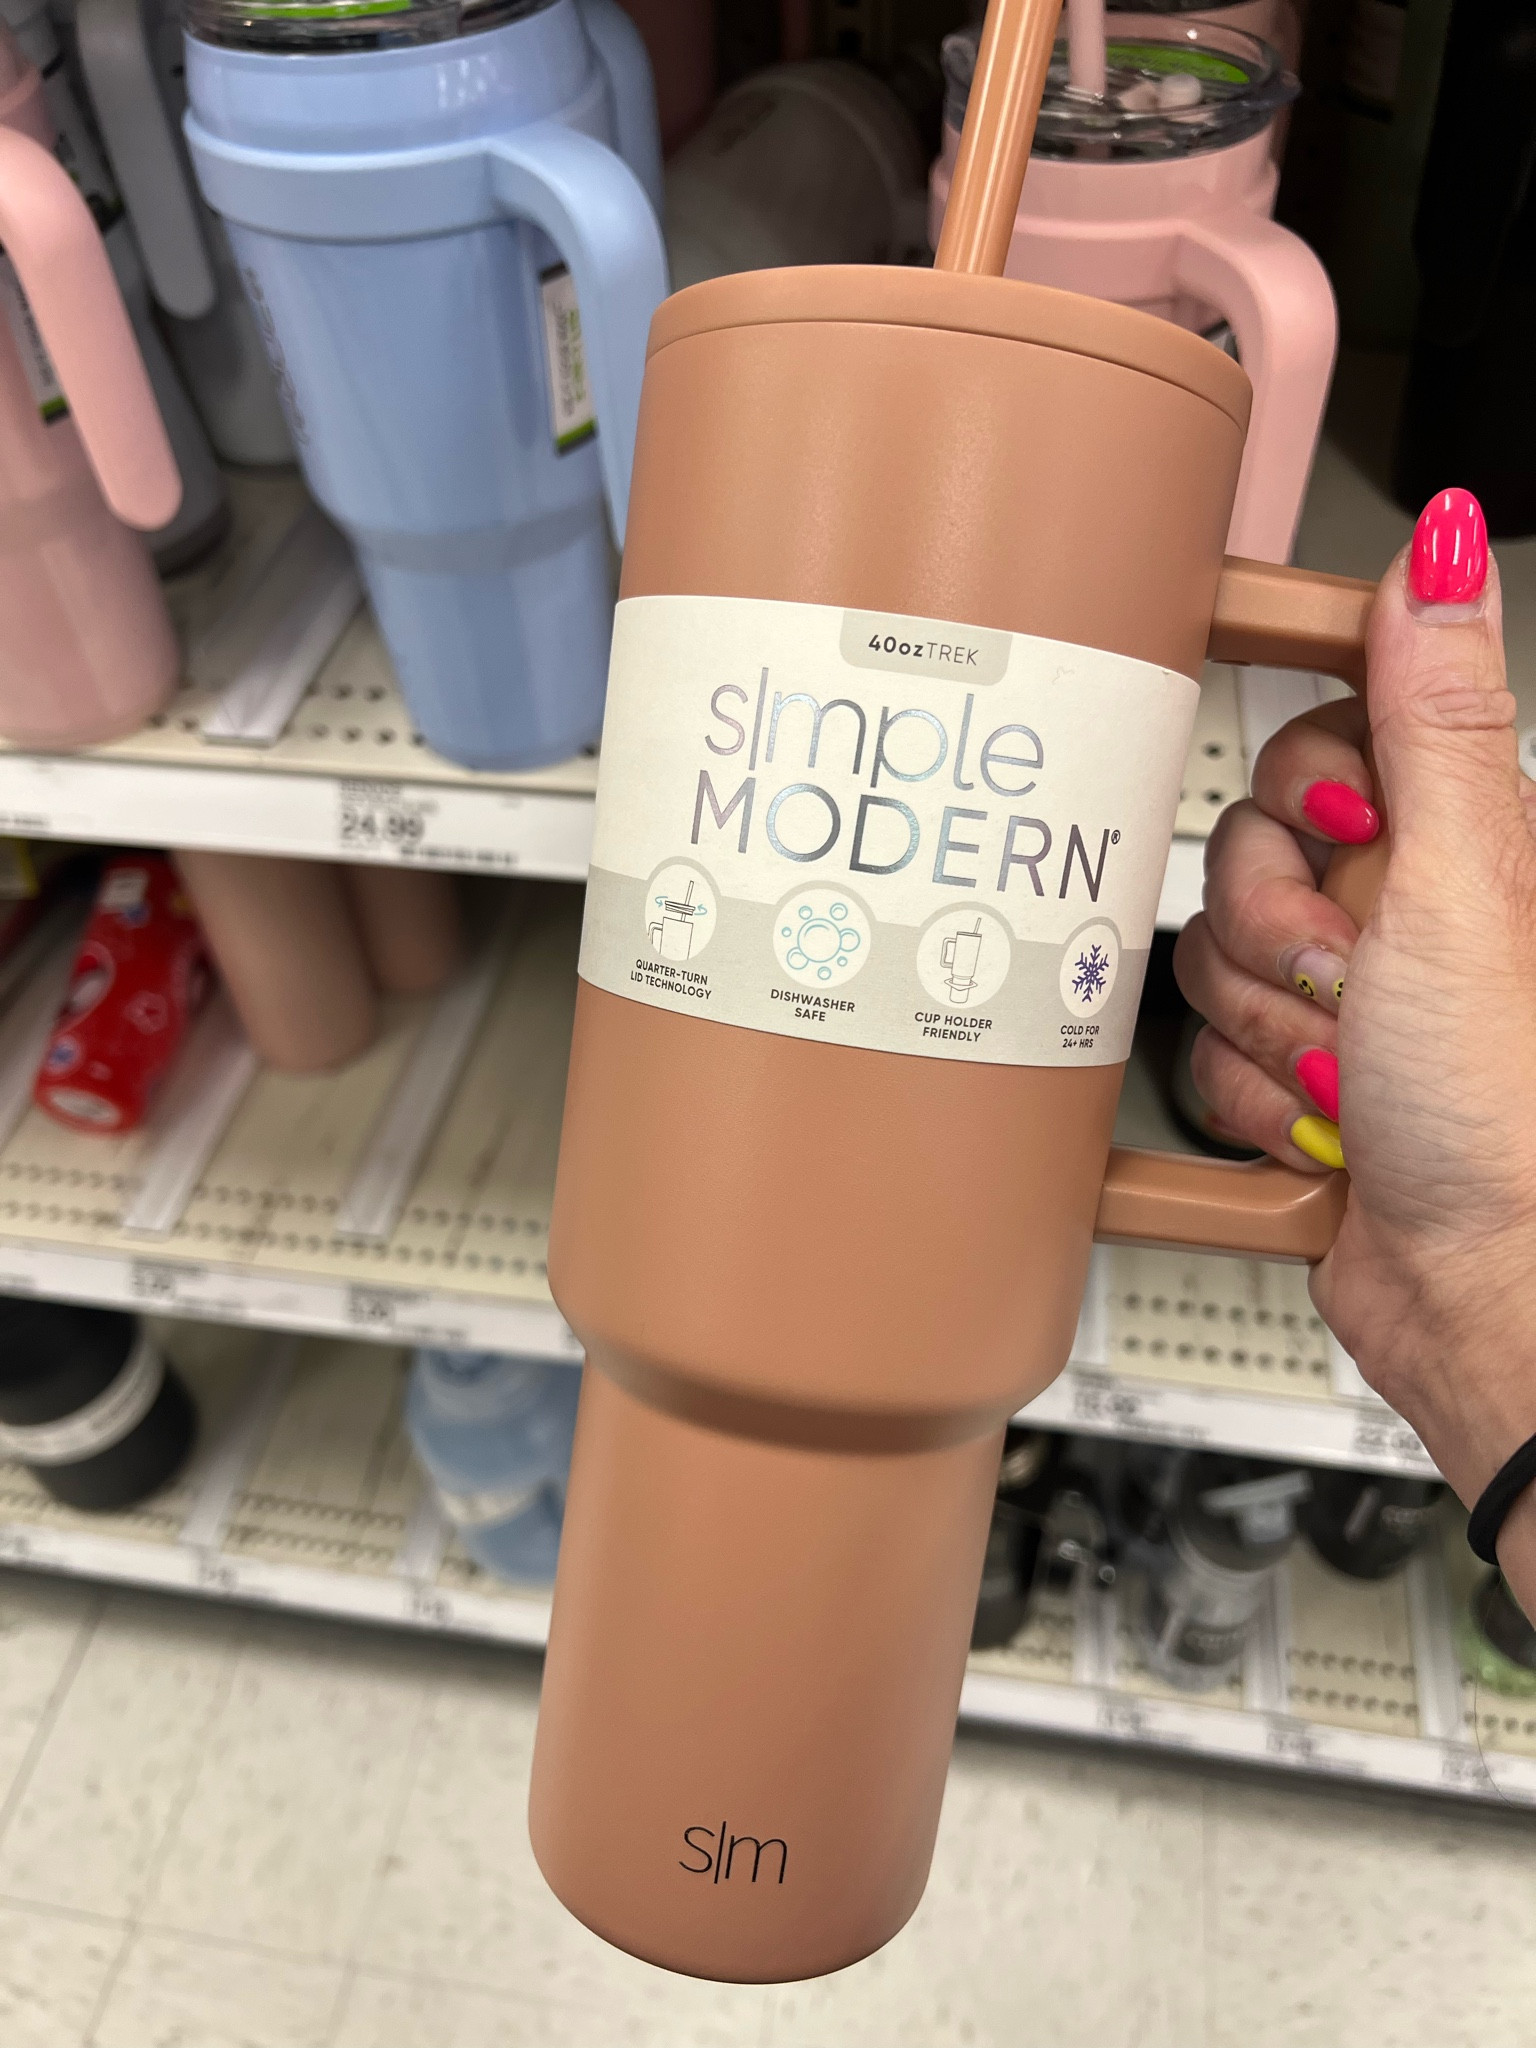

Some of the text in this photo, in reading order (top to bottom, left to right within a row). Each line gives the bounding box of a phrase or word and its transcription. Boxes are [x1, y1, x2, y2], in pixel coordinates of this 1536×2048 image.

[635, 959, 709, 986] QUARTER-TURN
[630, 970, 712, 1000] LID TECHNOLOGY
[770, 989, 856, 1013] DISHWASHER
[794, 1007, 827, 1022] SAFE
[914, 1012, 993, 1030] CUP HOLDER
[922, 1026, 982, 1043] FRIENDLY
[1060, 1025, 1100, 1036] COLD FOR
[1062, 1038, 1094, 1049] 24+ HRS
